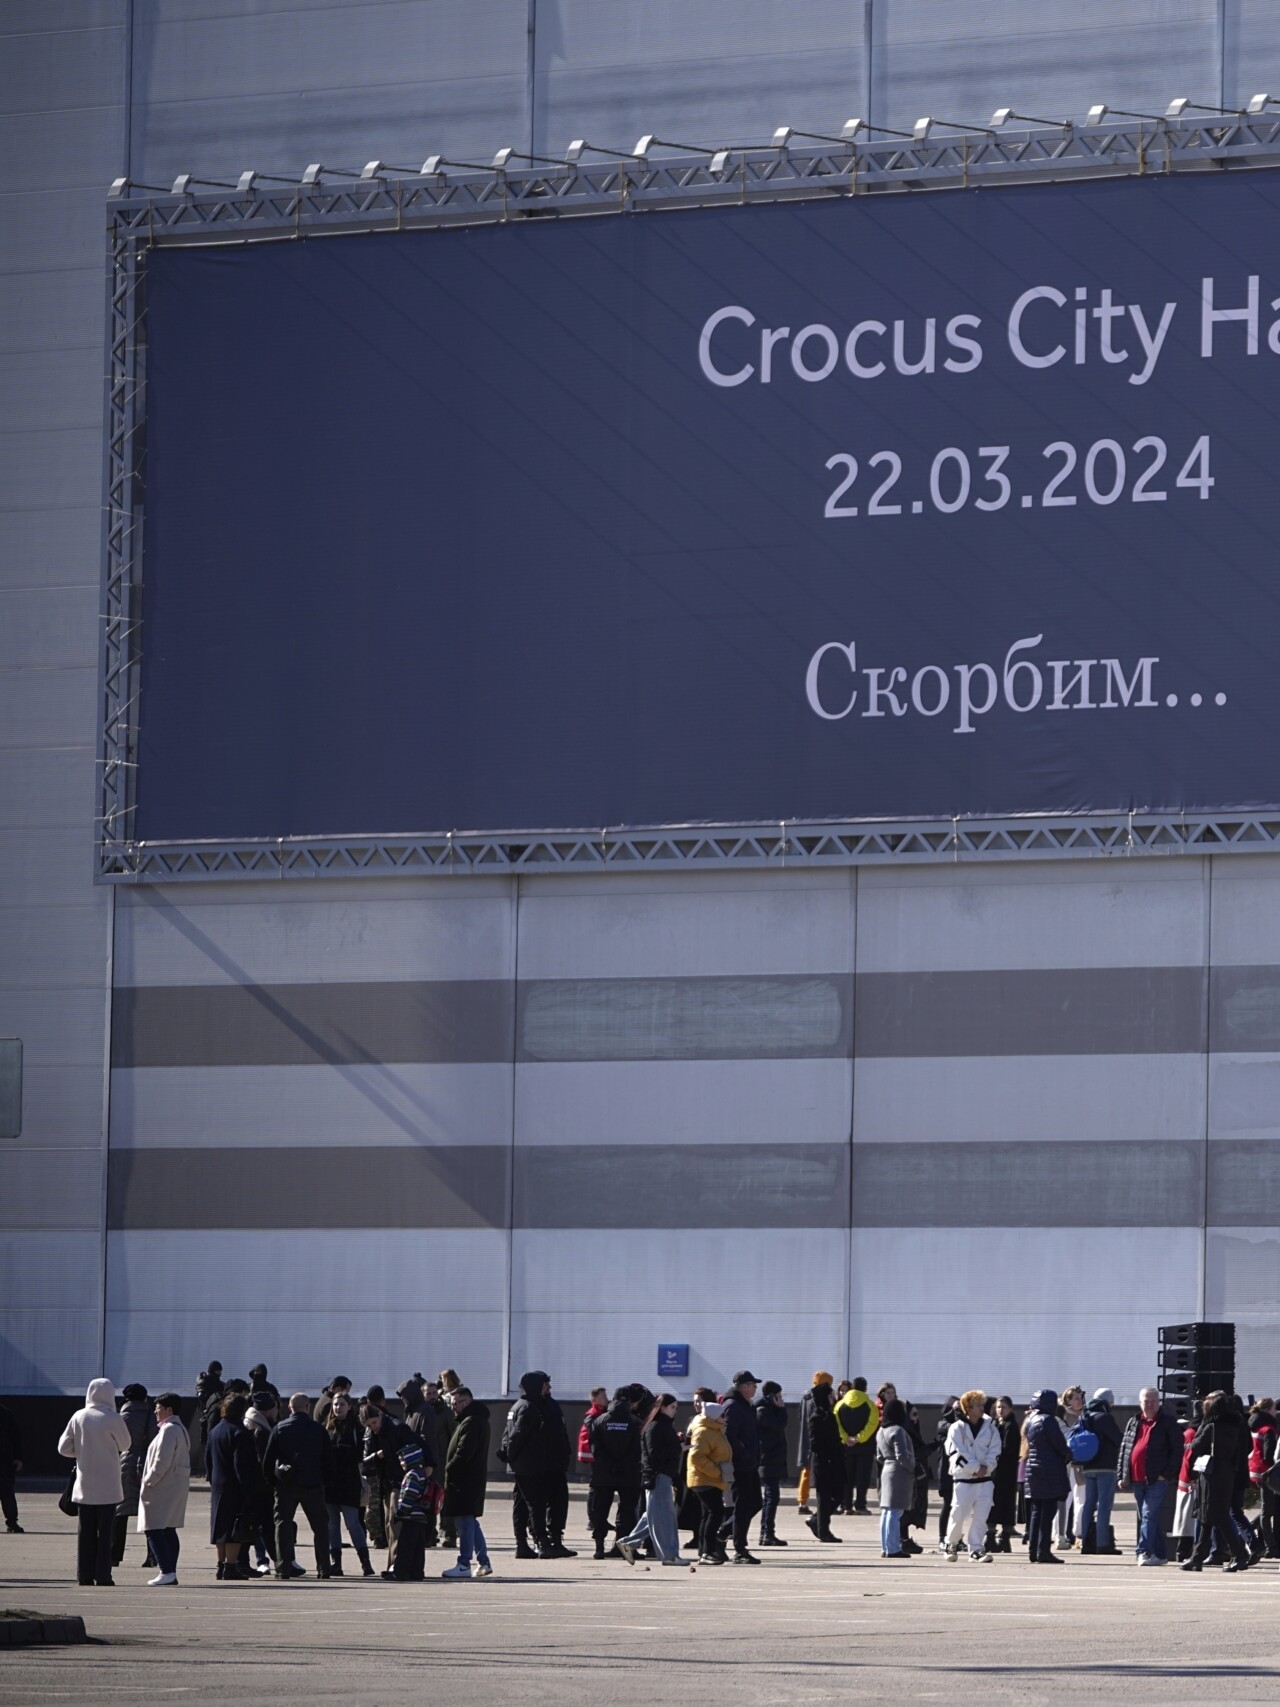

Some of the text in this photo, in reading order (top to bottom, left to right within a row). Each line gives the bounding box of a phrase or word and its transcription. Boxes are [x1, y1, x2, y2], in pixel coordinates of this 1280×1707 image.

[699, 305, 983, 388] Crocus
[1008, 285, 1178, 386] City
[823, 435, 1215, 519] 22.03.2024
[805, 633, 1228, 734] Скорбим...
